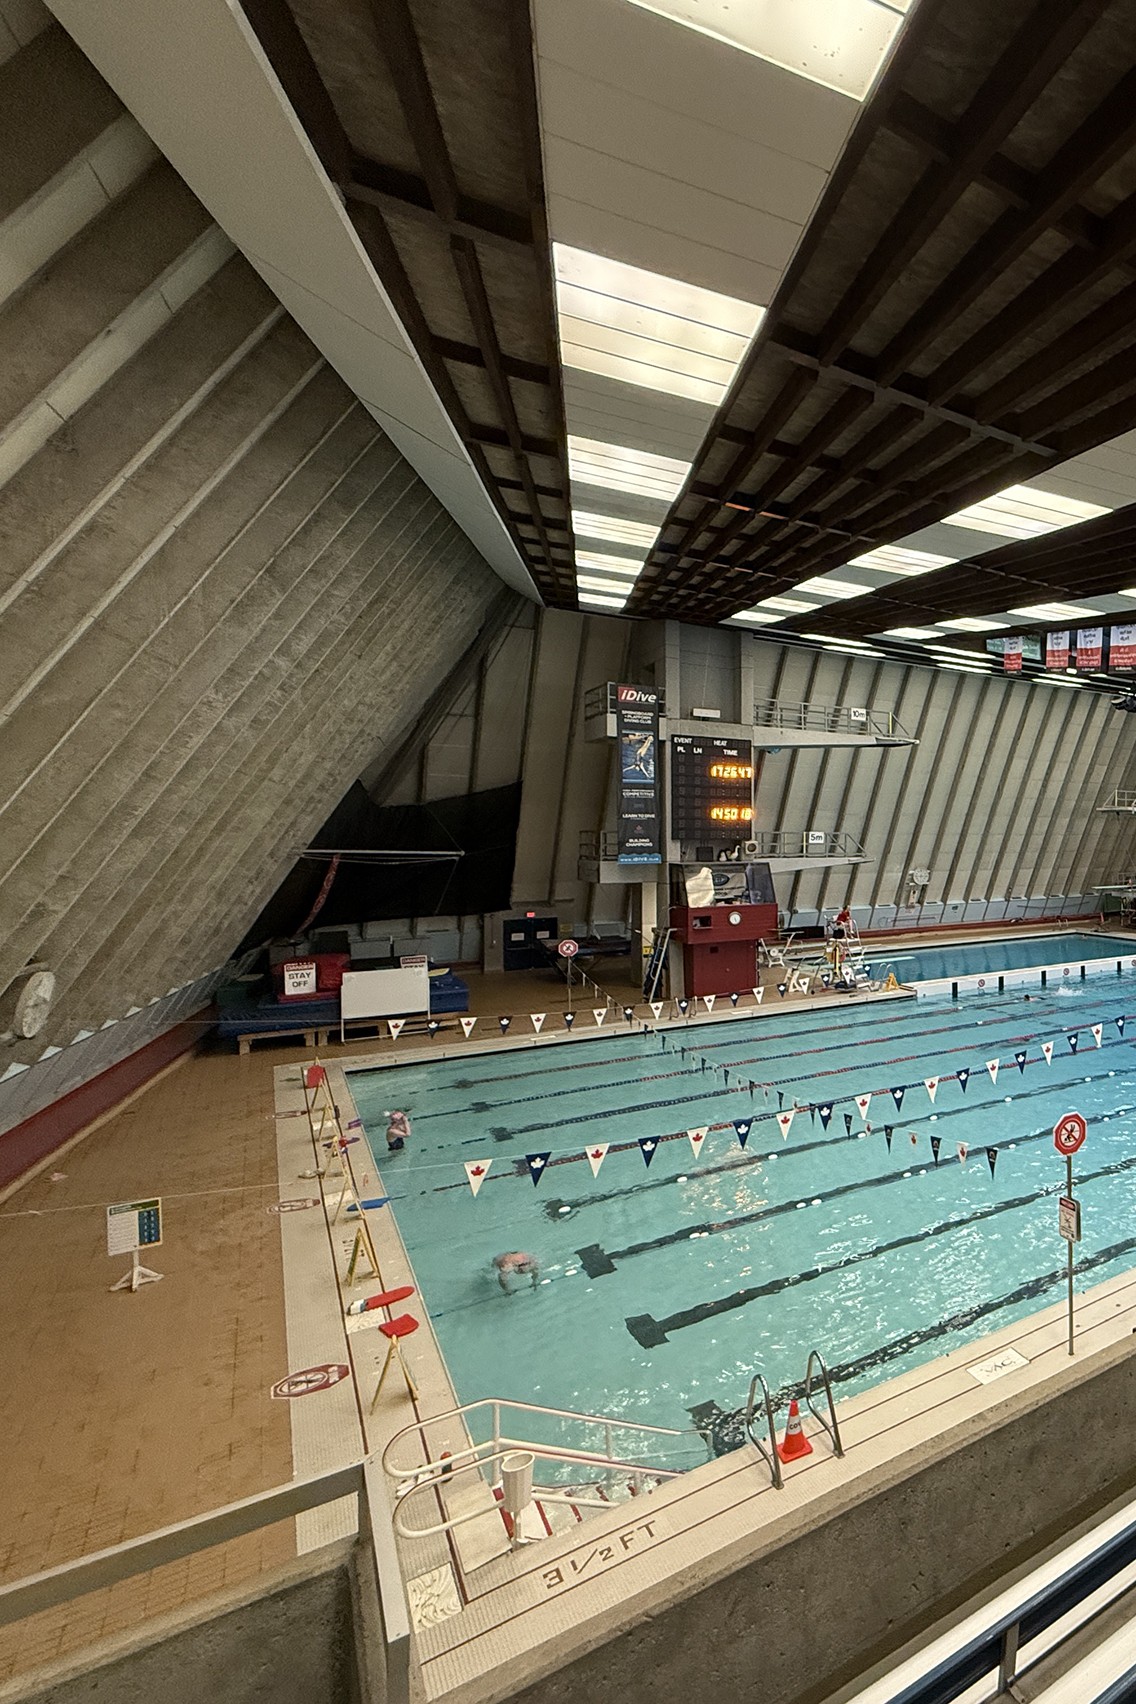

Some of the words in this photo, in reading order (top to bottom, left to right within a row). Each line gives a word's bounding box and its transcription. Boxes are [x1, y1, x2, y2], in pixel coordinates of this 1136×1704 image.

[621, 690, 657, 703] iDive
[852, 710, 866, 718] 10m
[288, 972, 311, 980] STAY
[292, 980, 308, 988] OFF
[542, 1567, 564, 1589] 3
[619, 1520, 655, 1550] FT
